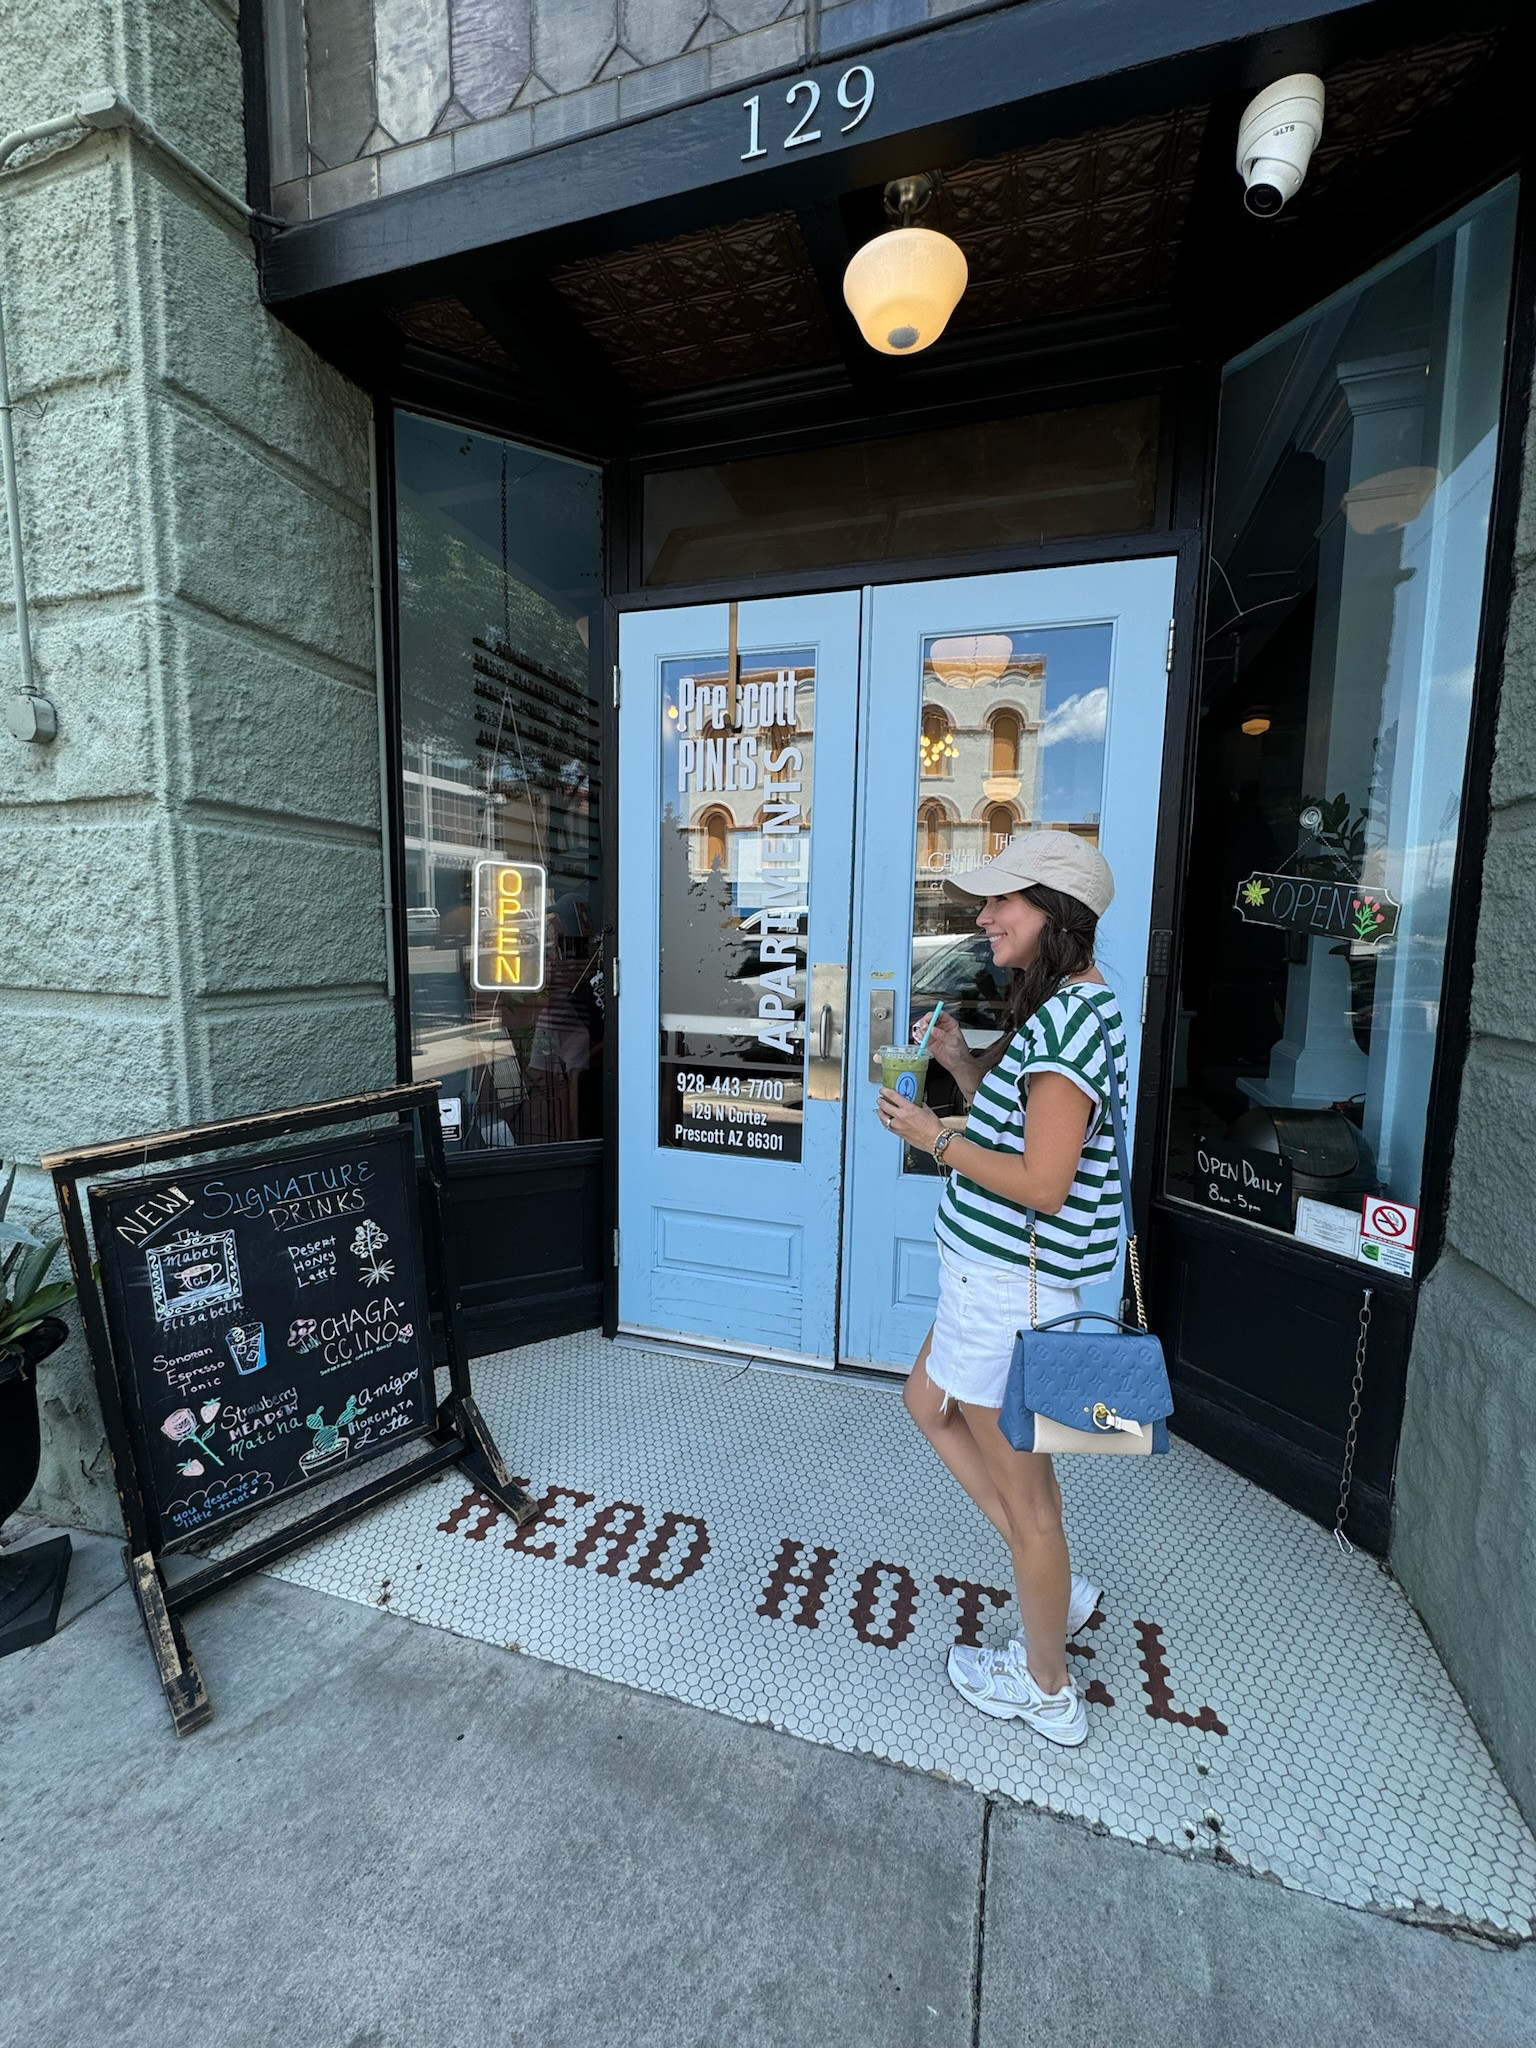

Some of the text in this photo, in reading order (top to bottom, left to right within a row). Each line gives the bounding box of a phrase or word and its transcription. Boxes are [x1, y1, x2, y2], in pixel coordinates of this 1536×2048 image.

[741, 65, 875, 160] 129
[1280, 125, 1295, 135] LTS
[679, 737, 758, 792] PINES
[758, 746, 803, 1055] APARTMENTS
[1272, 881, 1352, 930] OPEN
[495, 868, 524, 984] OPEN
[677, 1072, 784, 1101] 928-443-7700
[691, 1102, 767, 1126] 129 N Cortez
[675, 1124, 783, 1151] Prescott AZ 86301
[1198, 1150, 1239, 1181] OPEN
[202, 1161, 376, 1219] SIGNATURE
[268, 1188, 366, 1231] DRINKS
[116, 1185, 195, 1245] NEW!
[297, 1268, 338, 1288] Latte
[163, 1300, 245, 1332] Elizabeth
[324, 1321, 399, 1365] CCINO
[166, 1361, 225, 1386] Espresso
[177, 1377, 222, 1397] Tonic
[221, 1386, 299, 1430] Strawberry
[228, 1402, 299, 1441] MEADOW
[348, 1399, 414, 1435] HORCHATA
[354, 1413, 414, 1450] Latte
[173, 1477, 259, 1527] you deserve a
[183, 1492, 250, 1529] little treat
[756, 1538, 1229, 1736] HOTL
